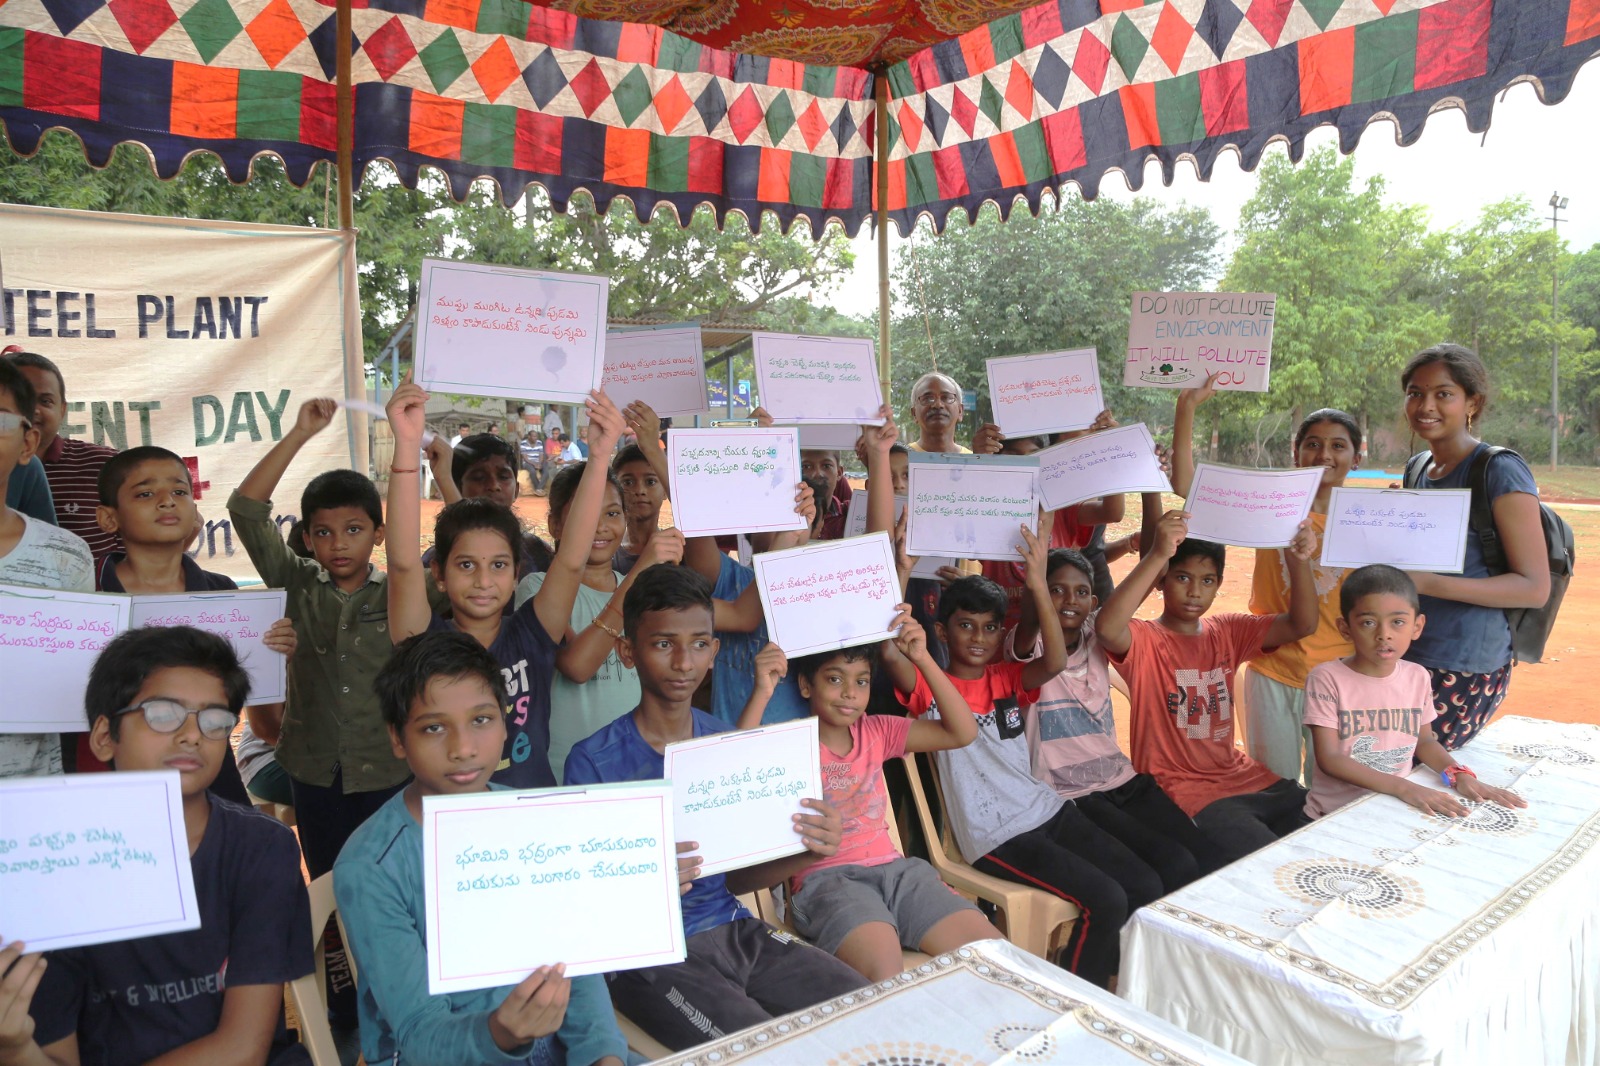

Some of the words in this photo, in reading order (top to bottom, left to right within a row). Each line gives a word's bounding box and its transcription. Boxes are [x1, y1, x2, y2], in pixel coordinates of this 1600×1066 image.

[1140, 296, 1168, 315] DO
[1173, 297, 1207, 316] NOT
[1208, 298, 1275, 316] POLLUTE
[136, 294, 268, 339] PLANT
[1155, 319, 1273, 338] ENVIRONMENT
[1127, 347, 1149, 362] IT
[1150, 346, 1190, 362] WILL
[1198, 346, 1268, 366] POLLUTE
[1205, 367, 1246, 386] YOU
[192, 389, 291, 447] DAY
[688, 780, 715, 796] ఉన్నది
[747, 785, 772, 801] నిండు
[776, 780, 807, 798] పున్నమి
[455, 845, 509, 870] భూమిని
[531, 868, 581, 886] బంగారం
